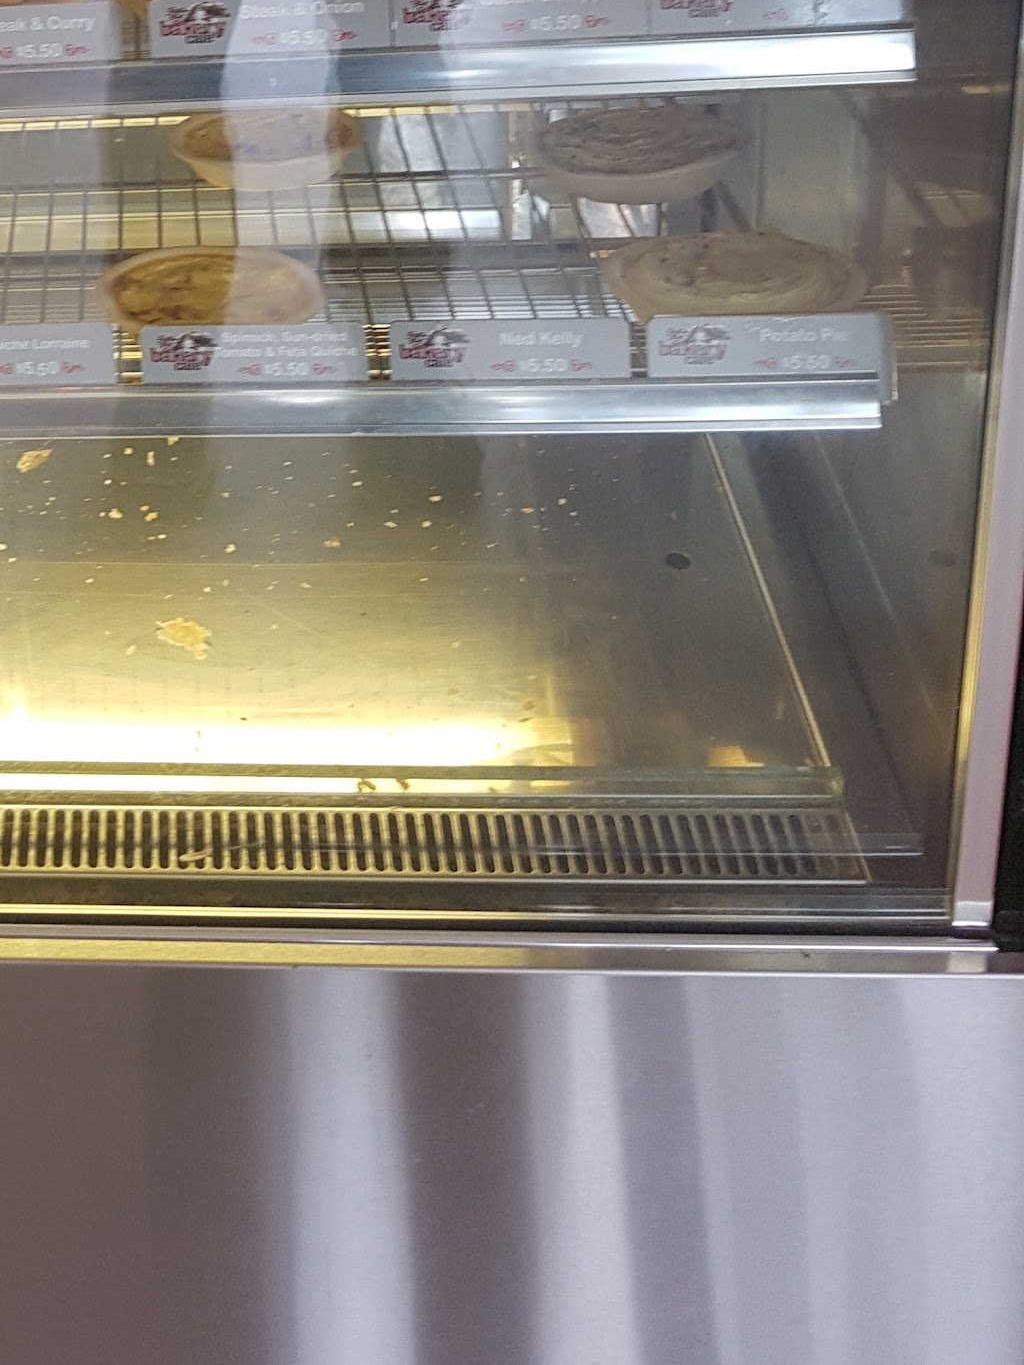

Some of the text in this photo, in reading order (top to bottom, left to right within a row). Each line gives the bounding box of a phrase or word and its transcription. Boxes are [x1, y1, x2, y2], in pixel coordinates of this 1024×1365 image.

[239, 0, 365, 20] Steak & Onion
[30, 17, 43, 31] &
[46, 14, 96, 32] Curry
[31, 337, 91, 350] Lorraine
[498, 330, 583, 348] Ned Kelly
[278, 346, 307, 356] Feta
[310, 345, 359, 357] Quiche
